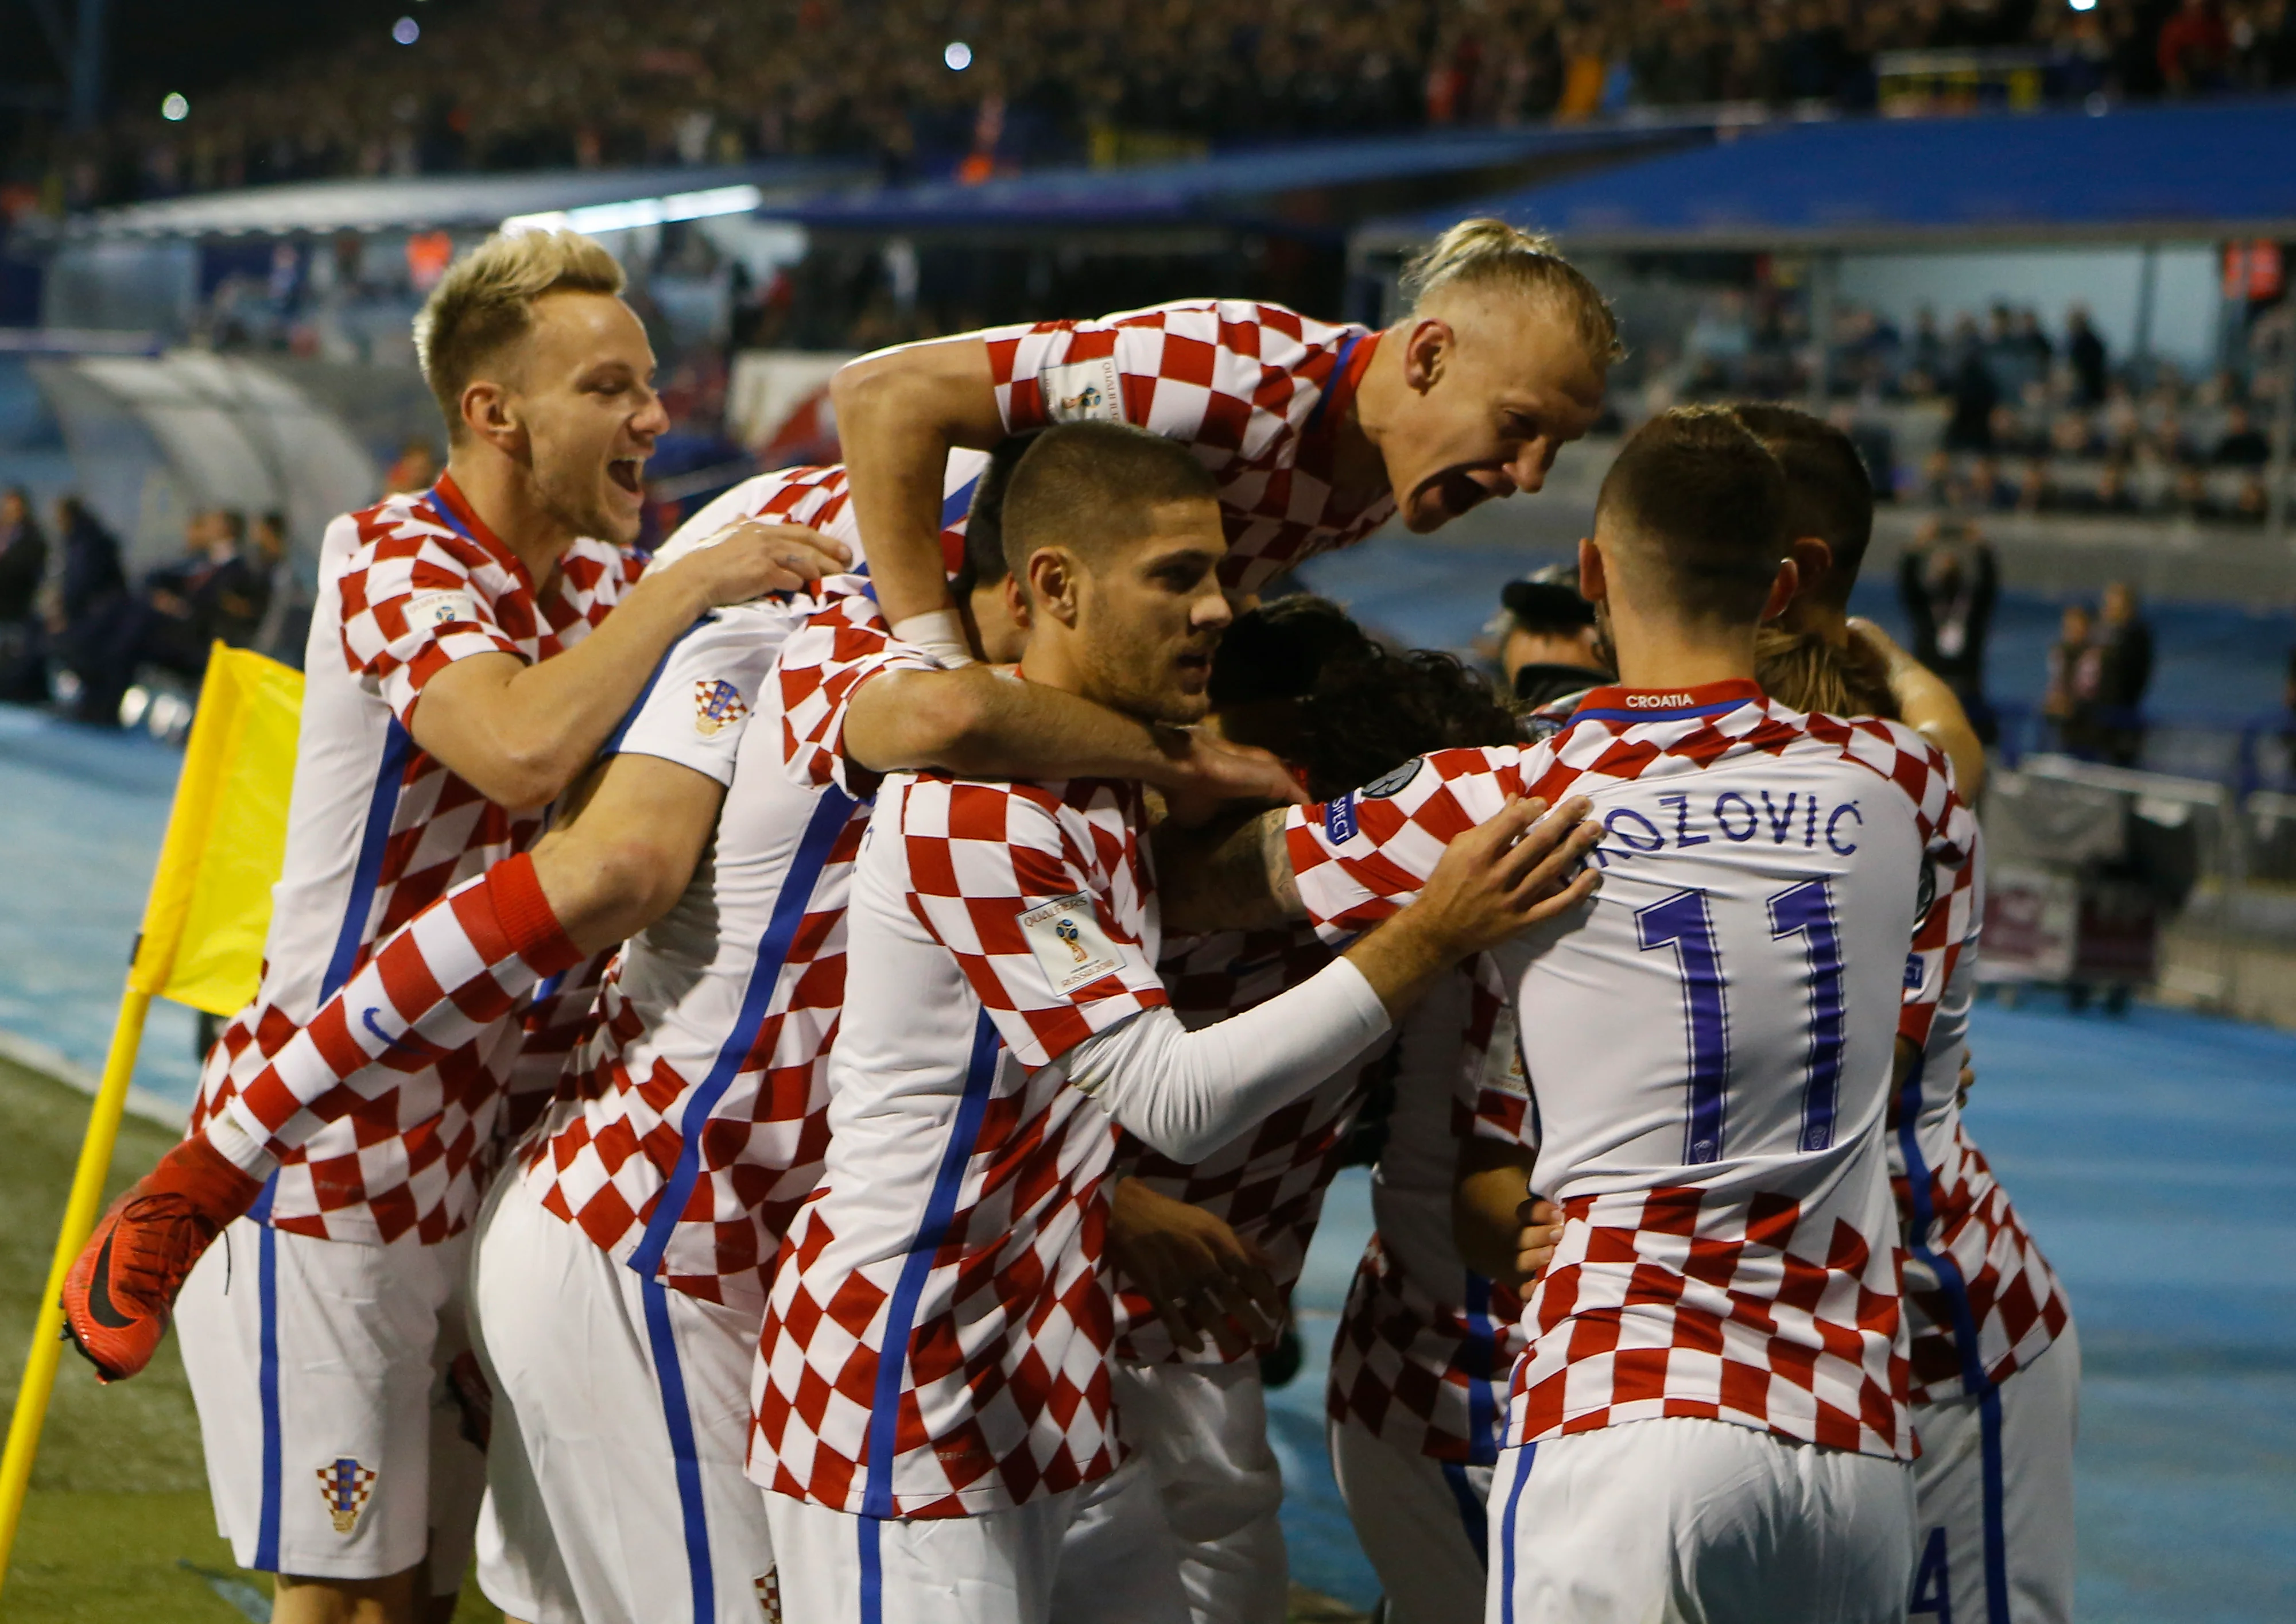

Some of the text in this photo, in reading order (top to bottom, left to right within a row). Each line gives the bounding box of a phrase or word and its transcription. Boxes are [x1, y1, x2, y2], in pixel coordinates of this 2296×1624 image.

[1625, 693, 1694, 708] CROATIA
[1332, 796, 1349, 841] SPECT
[1634, 874, 1845, 1166] 11
